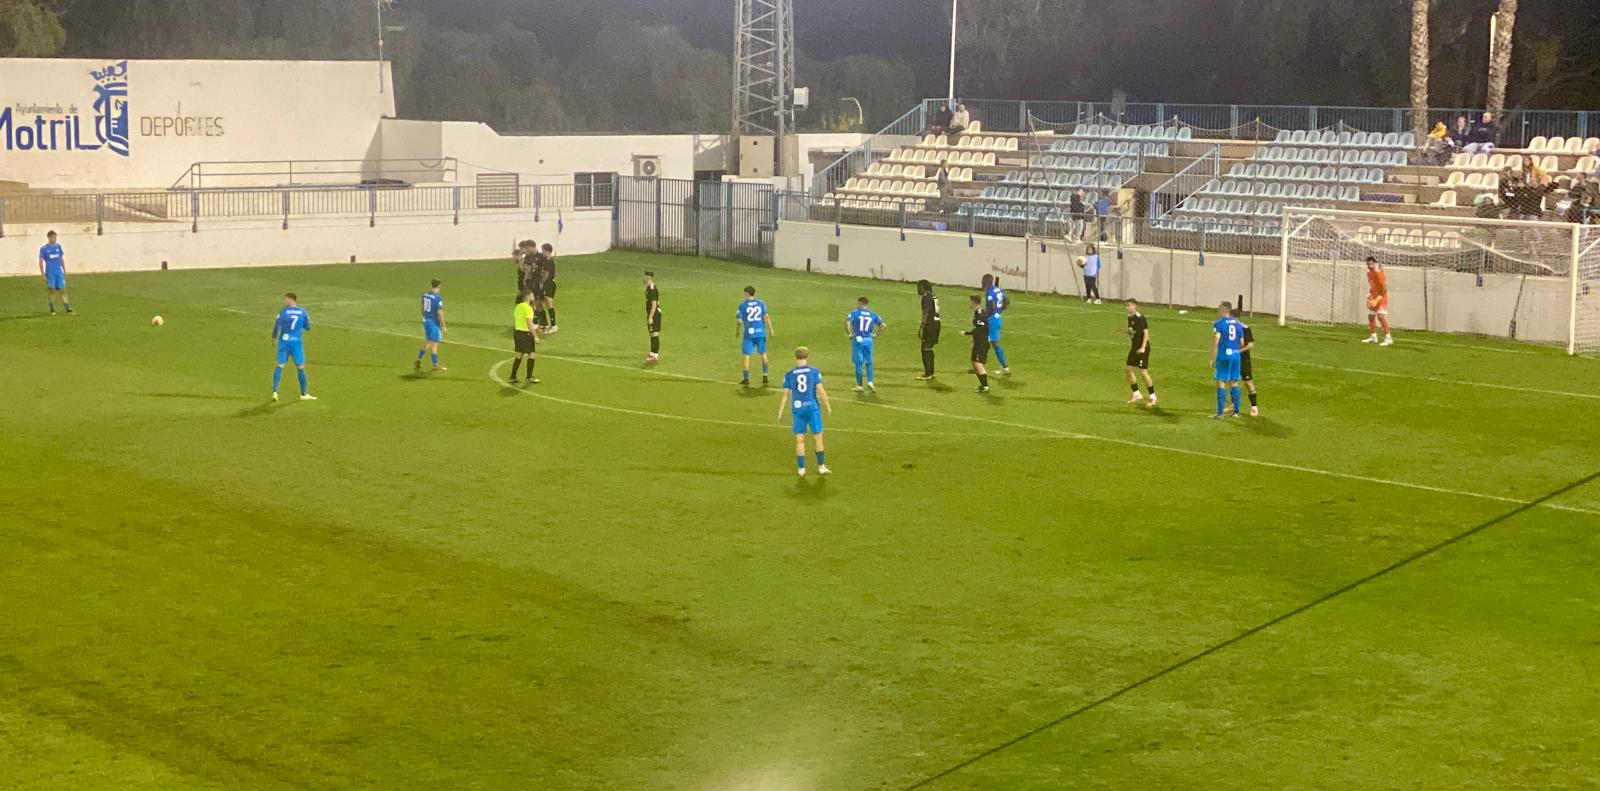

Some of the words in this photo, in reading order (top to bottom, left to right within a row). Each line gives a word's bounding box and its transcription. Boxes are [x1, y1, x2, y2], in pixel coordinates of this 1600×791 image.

[69, 103, 78, 114] de
[746, 306, 762, 322] 22
[290, 315, 299, 330] 7
[858, 315, 873, 332] 17
[1228, 324, 1236, 341] 9
[797, 374, 807, 393] 8
